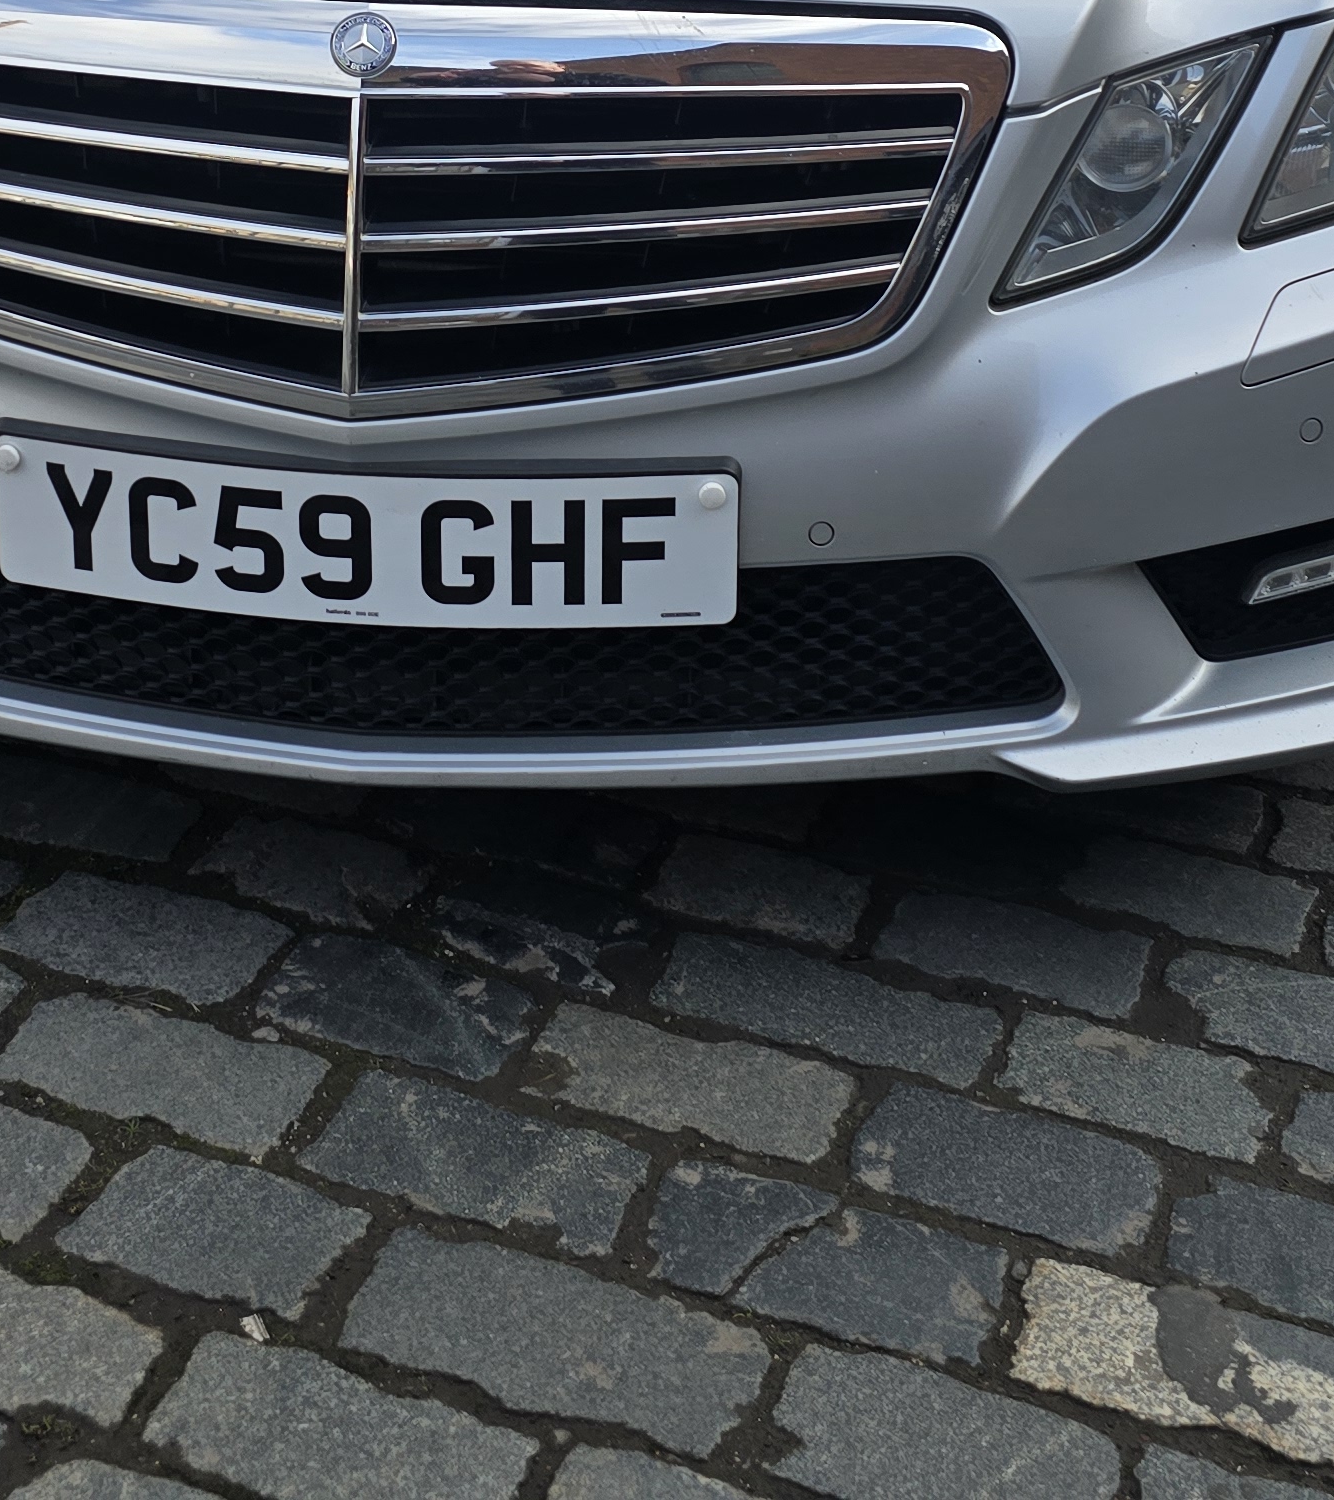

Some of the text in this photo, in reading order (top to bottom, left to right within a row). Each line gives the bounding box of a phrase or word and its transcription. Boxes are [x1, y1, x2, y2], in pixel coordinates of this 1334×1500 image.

[350, 63, 374, 71] BENZ
[45, 462, 676, 606] YC59 GHF
